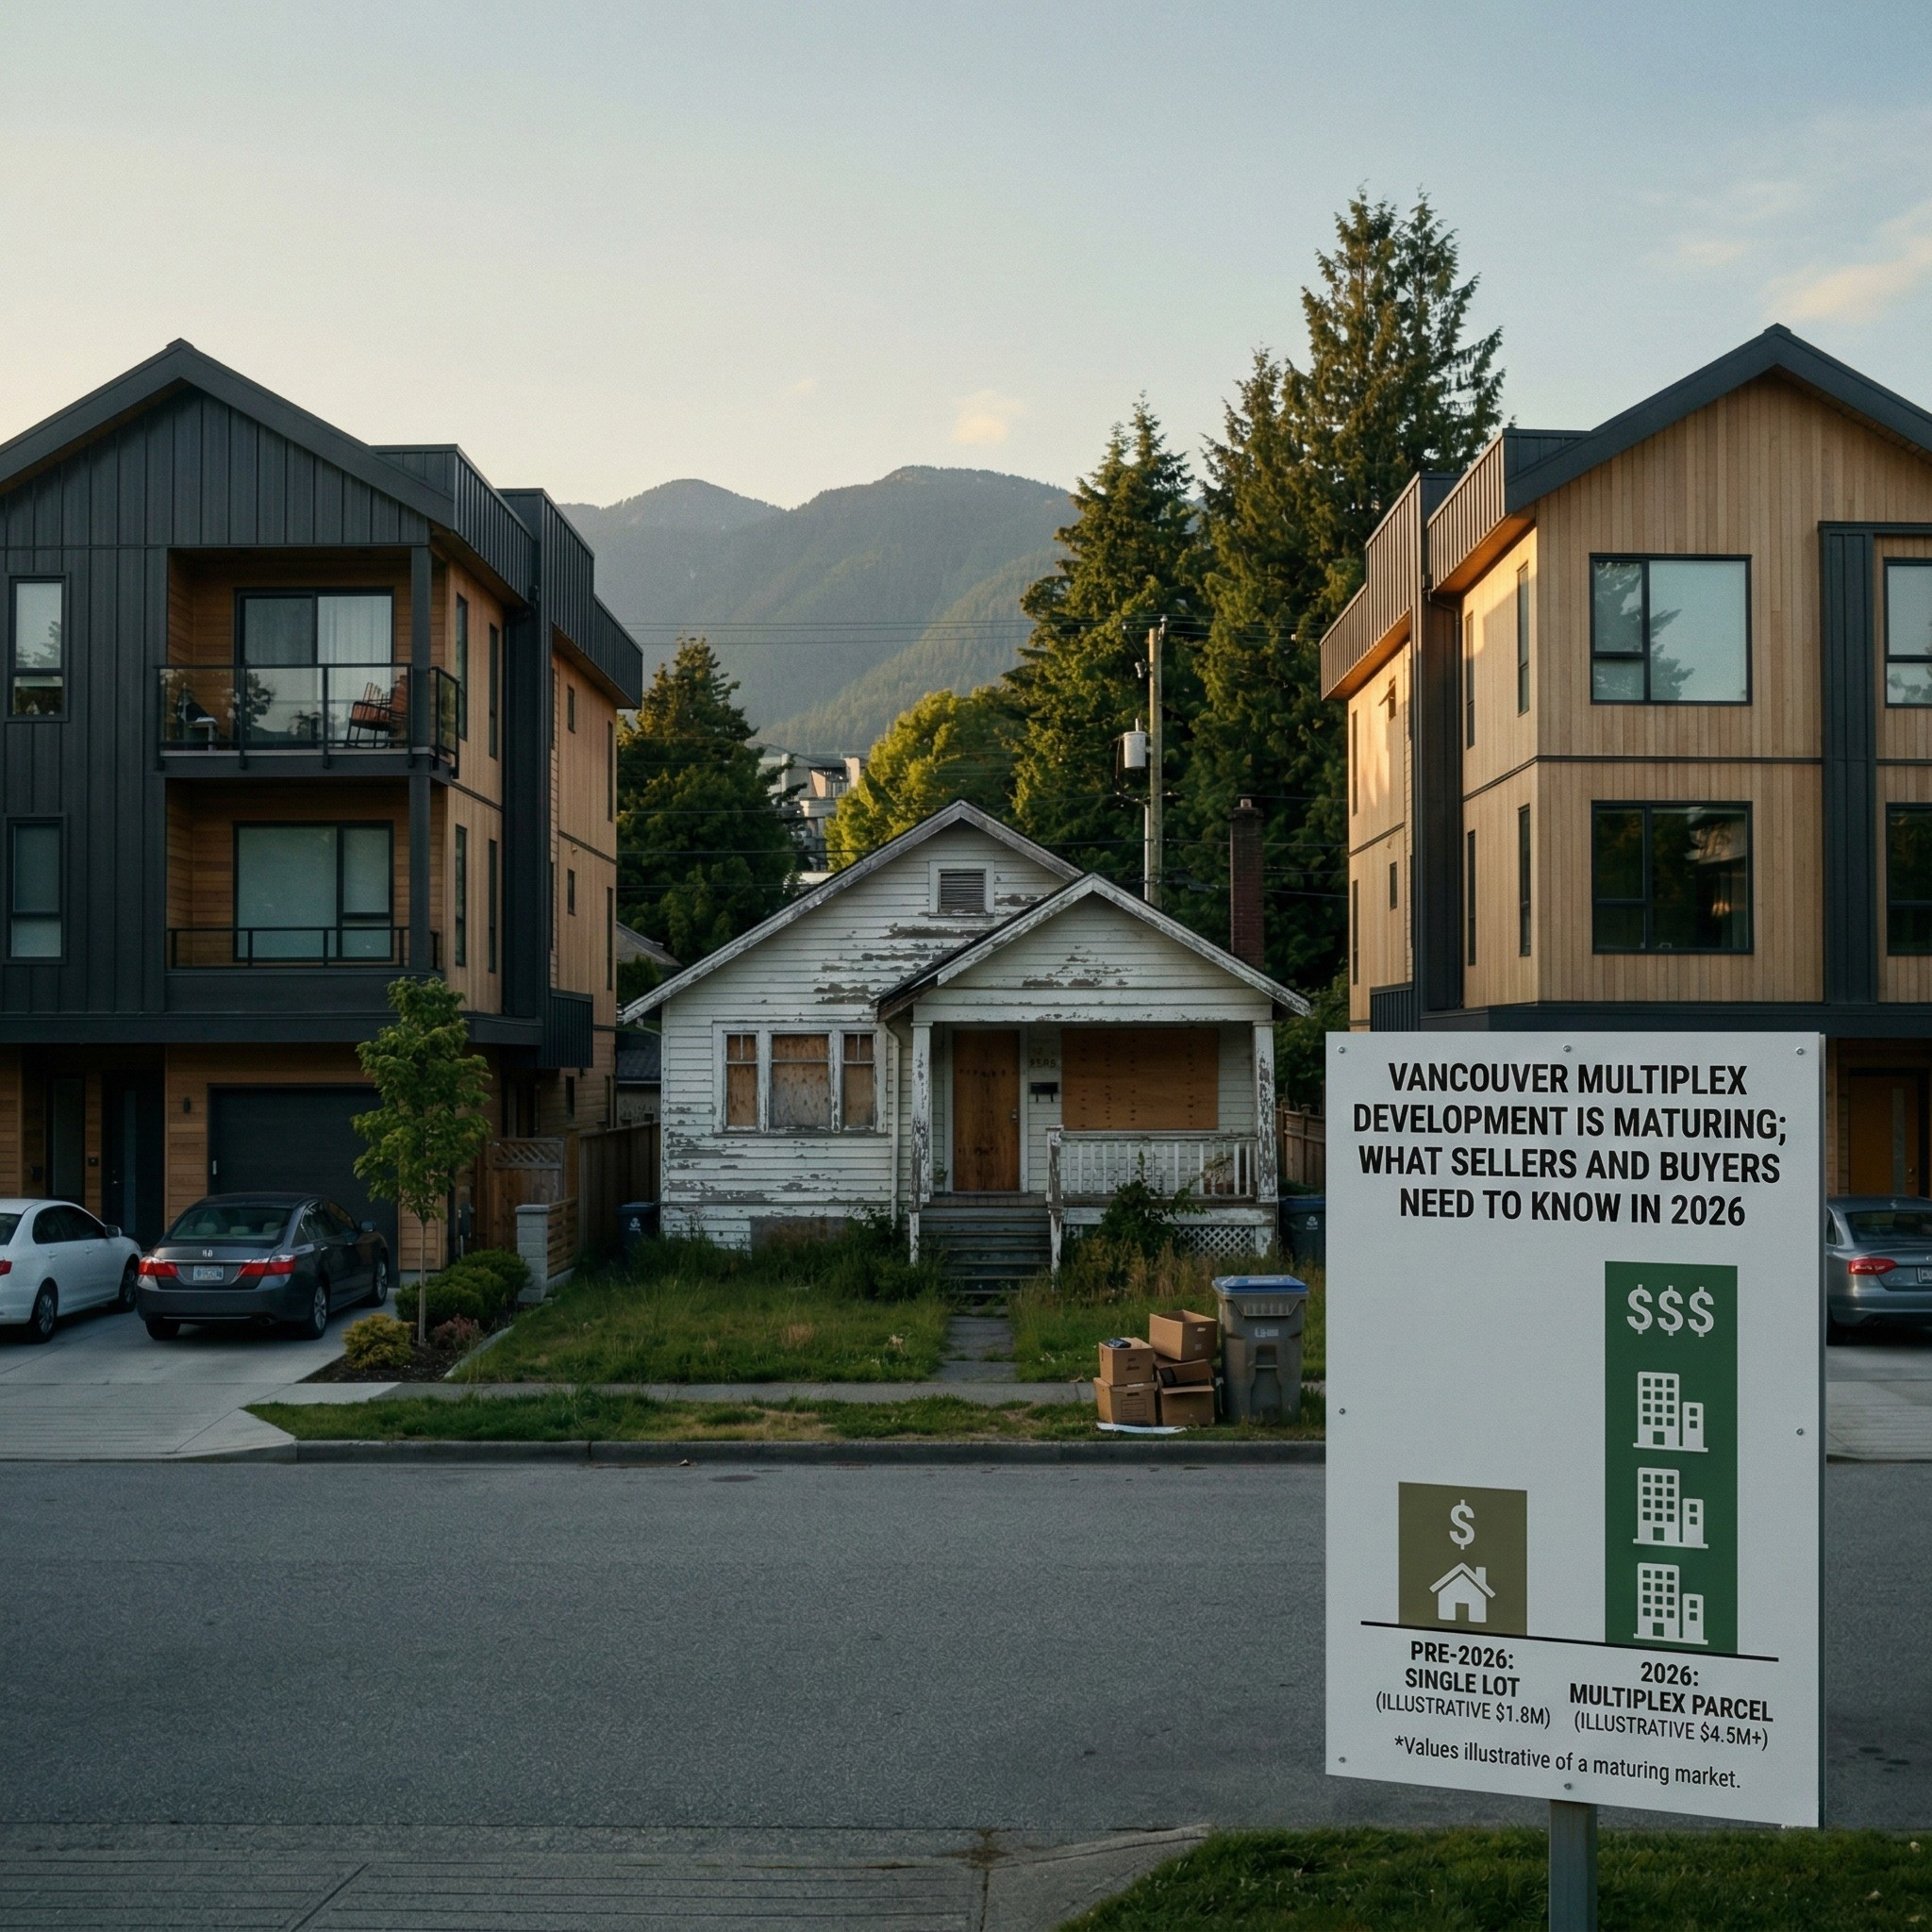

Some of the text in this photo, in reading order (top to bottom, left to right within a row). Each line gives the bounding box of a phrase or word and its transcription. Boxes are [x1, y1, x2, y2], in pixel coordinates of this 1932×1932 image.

[1388, 1062, 1748, 1096] VANCOUVER MULTIPLEX
[1353, 1103, 1787, 1147] DEVELOPMENT IS MATURING;
[1357, 1144, 1781, 1184] WHAT SELLERS AND BUYERS
[1400, 1187, 1746, 1227] NEED TO KNOW IN 2026
[1626, 1284, 1714, 1338] $$$
[1449, 1499, 1475, 1550] $
[1410, 1640, 1514, 1671] PRE-2026:
[1640, 1660, 1699, 1688] 2026:
[1405, 1667, 1521, 1698] SINGLE LOT
[1569, 1682, 1774, 1723] MULTIPLEX PARCEL
[1375, 1690, 1551, 1730] (ILLUSTRATIVE $1.8M)
[1574, 1709, 1769, 1752] (ILLUSTRATIVE $4.5M+)
[1464, 1741, 1551, 1770] illustrative
[1555, 1751, 1574, 1772] of
[1577, 1757, 1589, 1774] a
[1592, 1758, 1670, 1786] maturing
[1674, 1765, 1741, 1790] market.
